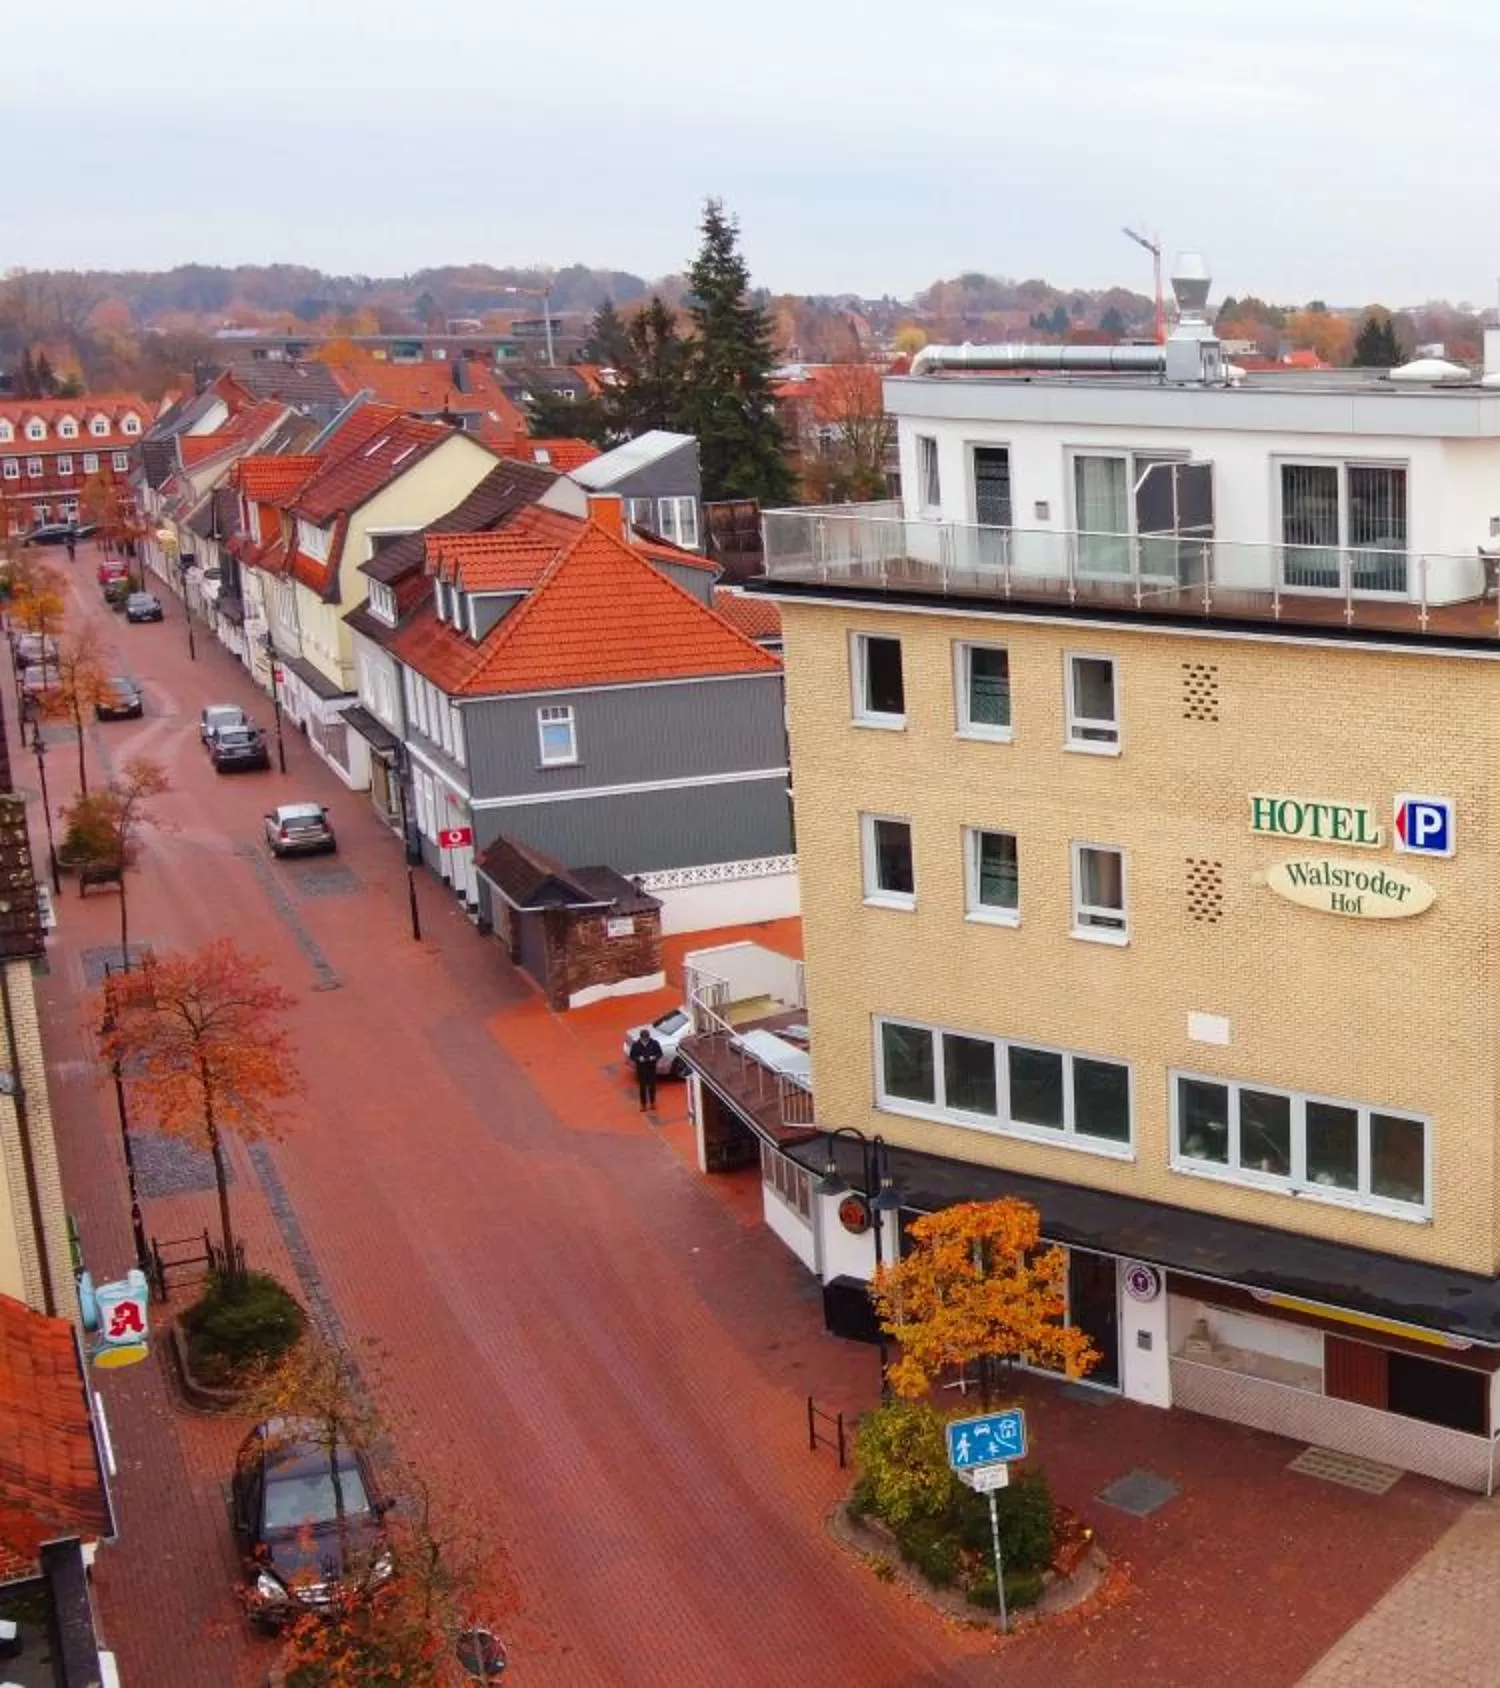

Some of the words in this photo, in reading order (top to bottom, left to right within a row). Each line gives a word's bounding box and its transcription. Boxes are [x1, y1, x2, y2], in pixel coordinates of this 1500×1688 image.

[1252, 796, 1379, 845] HOTEL
[1415, 805, 1443, 845] P
[1286, 861, 1412, 903] Walsroder
[1330, 891, 1364, 915] Hof
